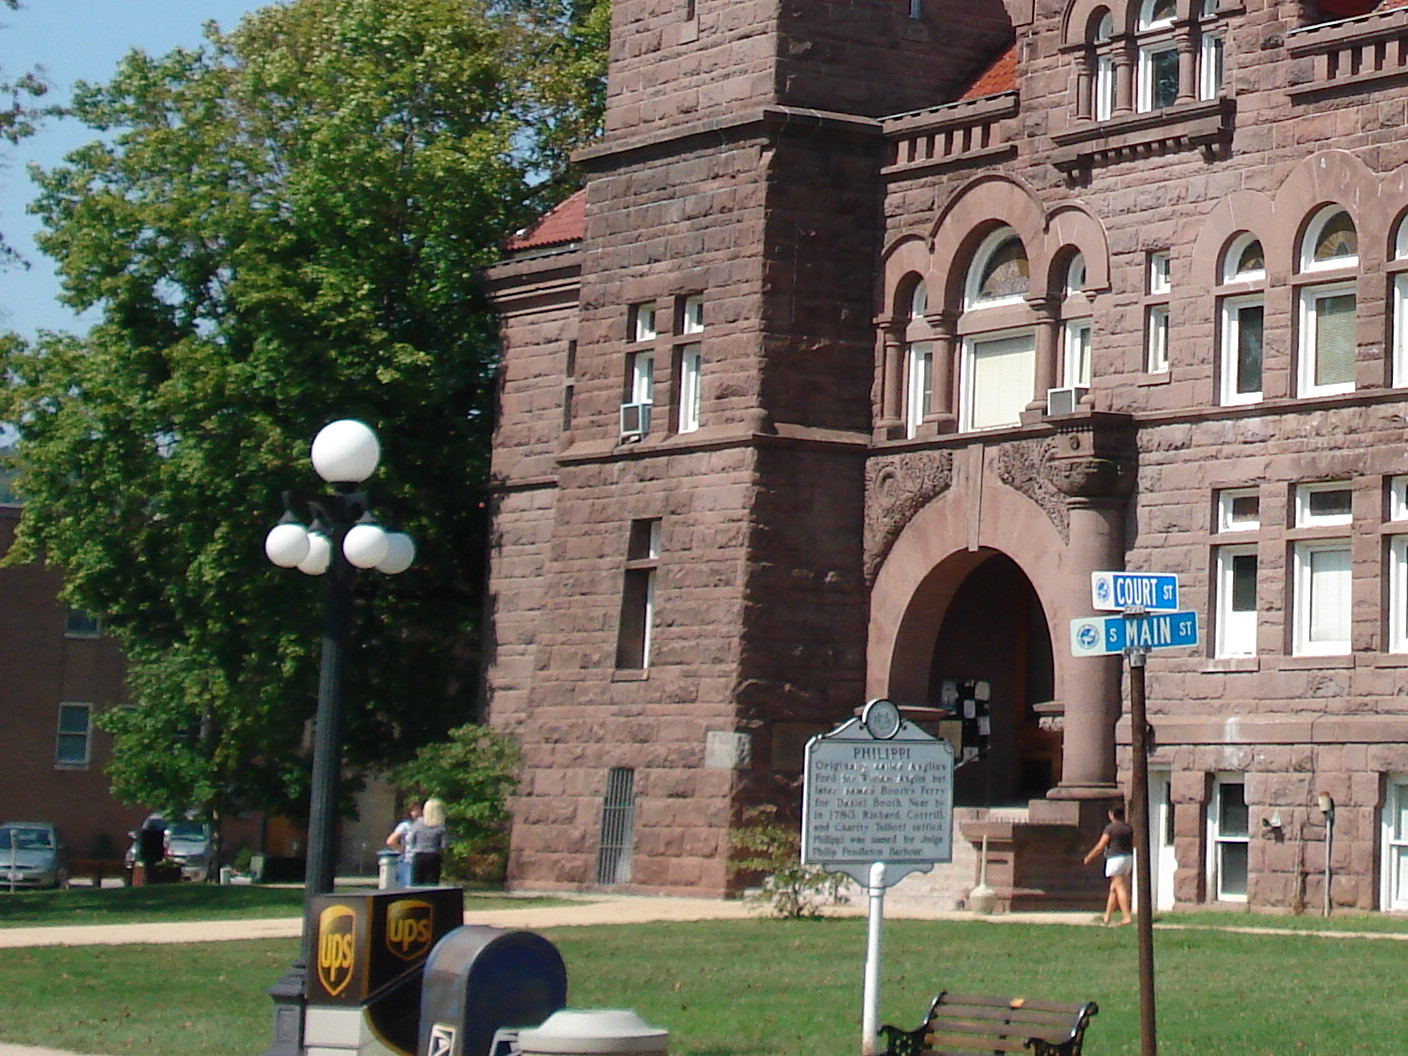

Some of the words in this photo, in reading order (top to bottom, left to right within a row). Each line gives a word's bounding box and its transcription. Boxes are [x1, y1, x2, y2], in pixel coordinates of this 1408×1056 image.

[1116, 577, 1157, 606] COURT
[1163, 585, 1174, 600] ST
[1109, 628, 1117, 642] S
[1125, 617, 1171, 646] MAIN
[1179, 621, 1192, 636] ST
[854, 747, 911, 760] PHILIPPI
[815, 773, 836, 783] Ford
[841, 773, 855, 783] for
[932, 774, 946, 783] but
[815, 786, 837, 796] later
[844, 786, 875, 796] named
[920, 786, 945, 797] Ferry
[815, 798, 829, 808] for
[837, 798, 867, 808] Daniel
[908, 798, 929, 807] Near
[814, 810, 823, 820] in
[863, 810, 900, 820] Richard
[813, 823, 830, 832] and
[834, 823, 870, 834] Charity
[389, 918, 430, 952] ups
[321, 932, 351, 982] ups
